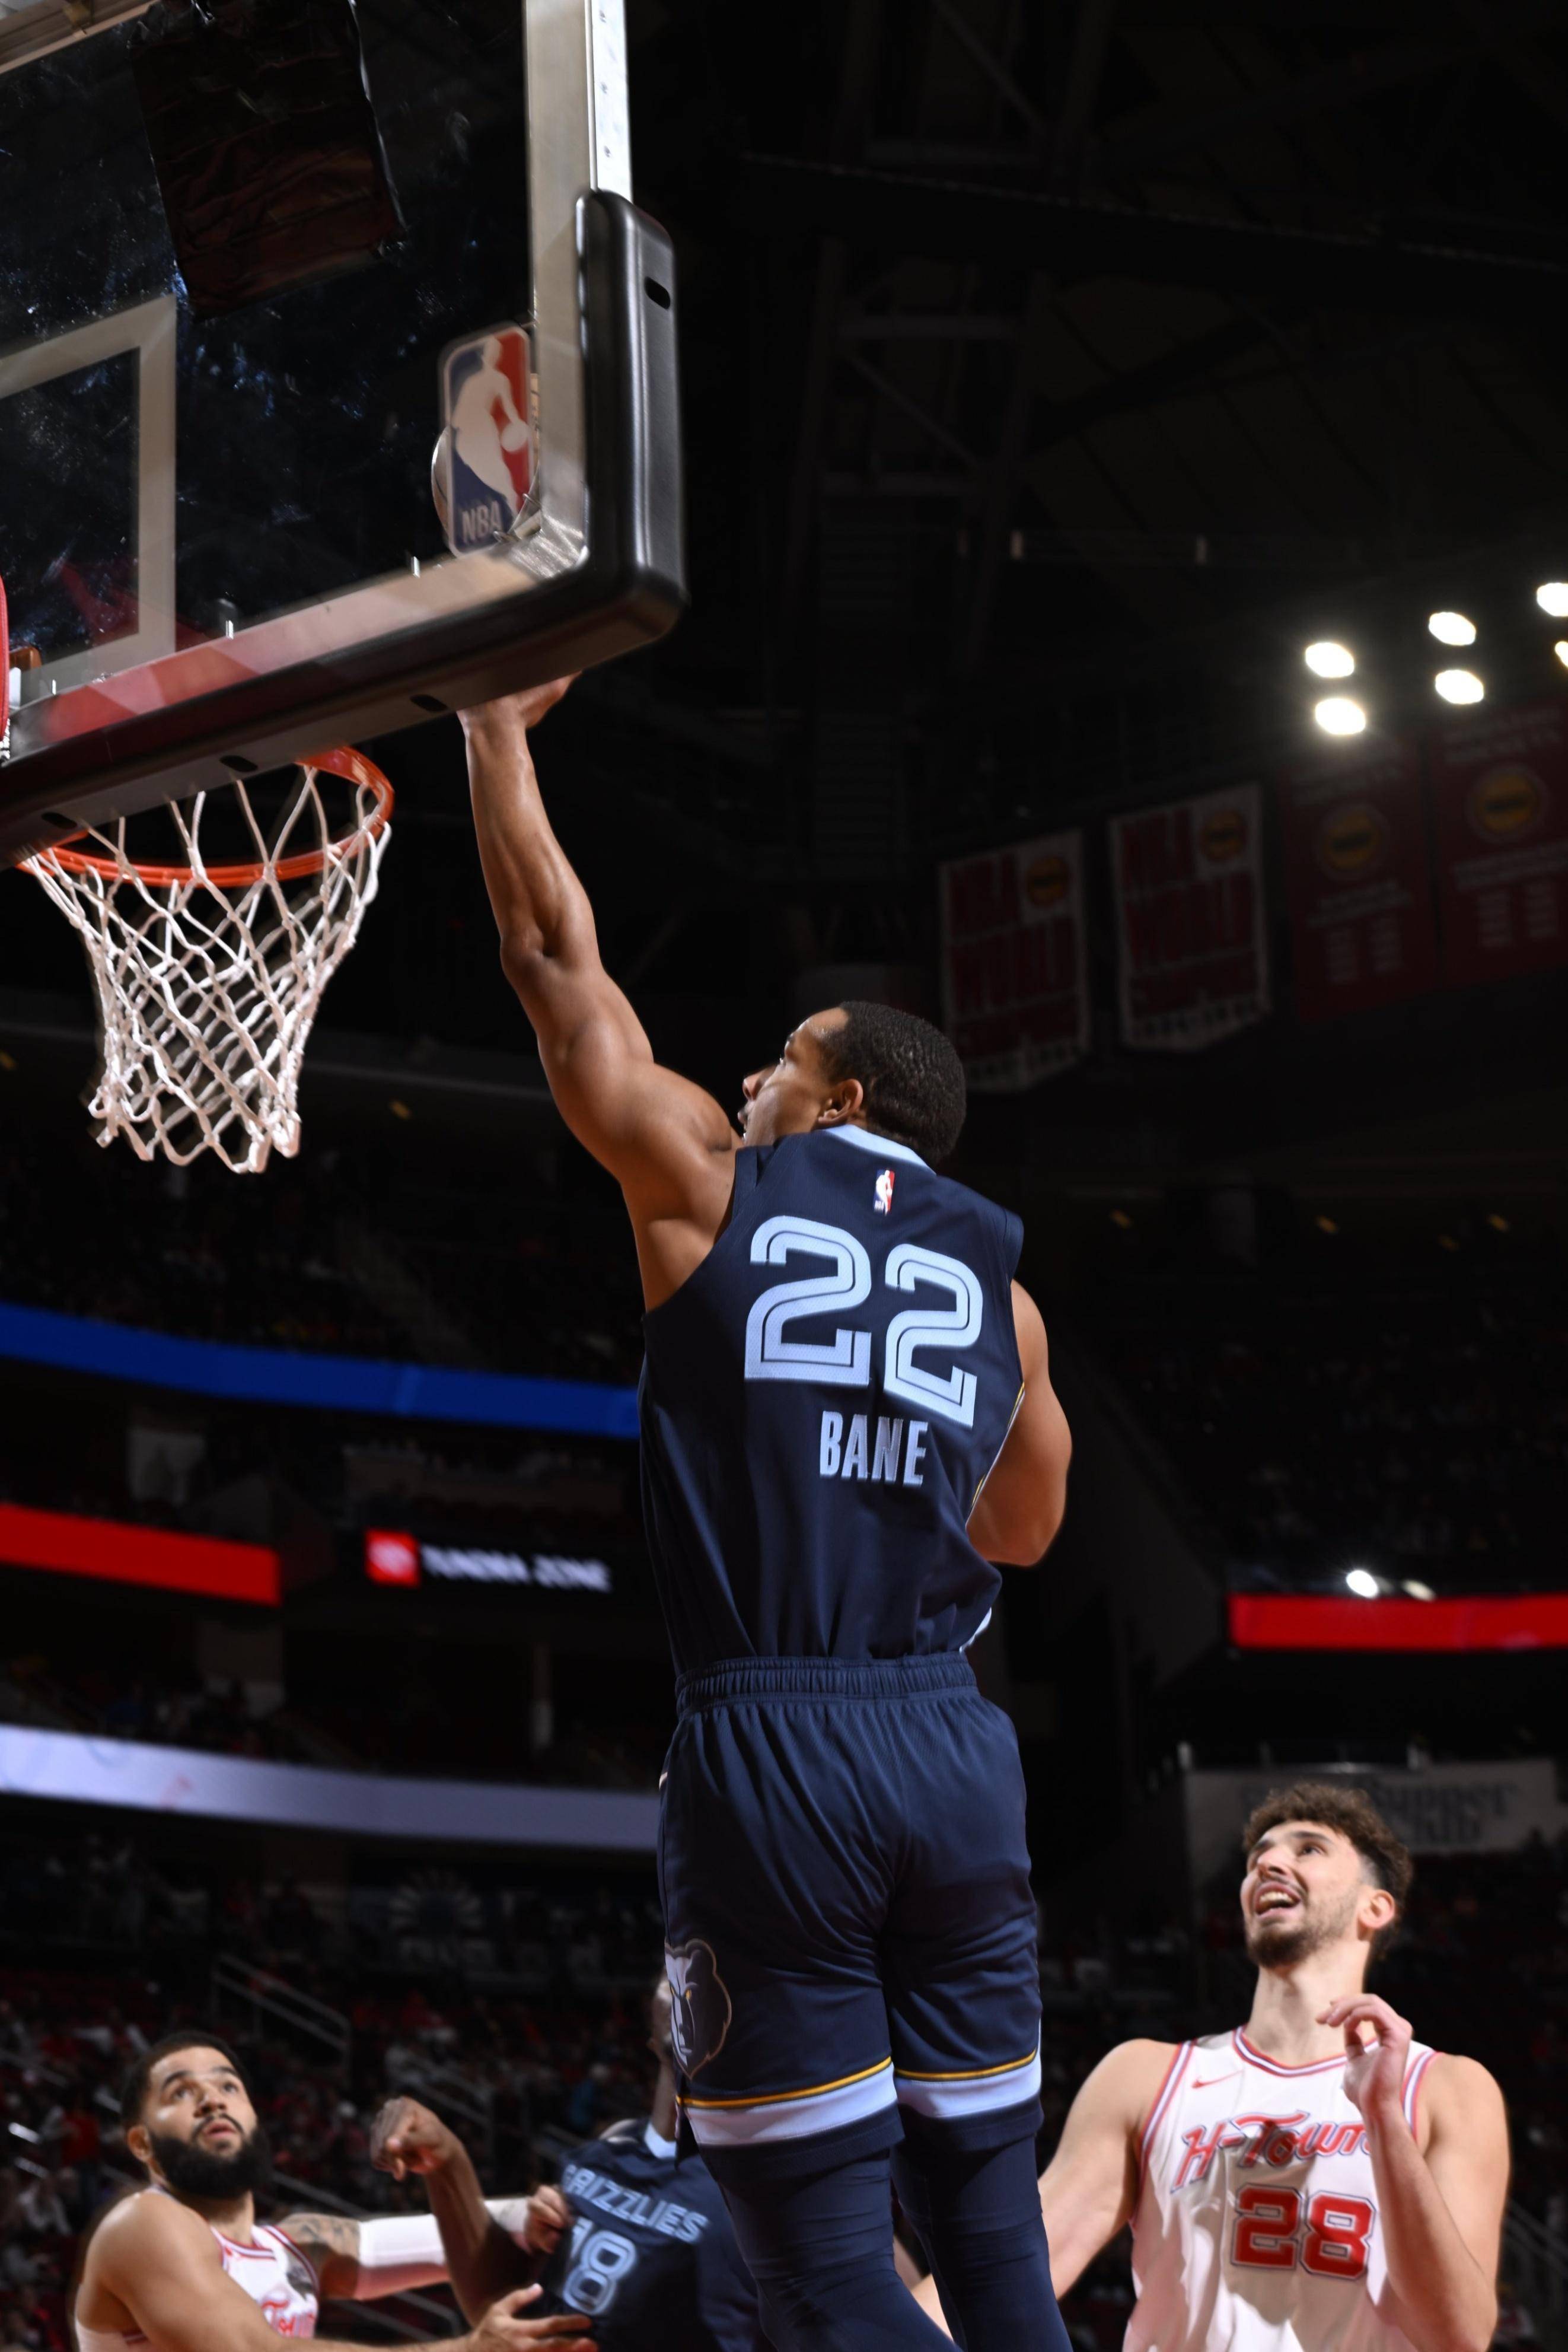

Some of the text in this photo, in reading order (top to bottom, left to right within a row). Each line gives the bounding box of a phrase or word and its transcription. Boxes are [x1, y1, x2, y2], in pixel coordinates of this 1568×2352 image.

[462, 500, 503, 543] NBA
[744, 1215, 983, 1429] 22
[819, 1410, 929, 1487] BANE
[563, 2216, 637, 2315] 18
[1230, 2182, 1376, 2281] 28
